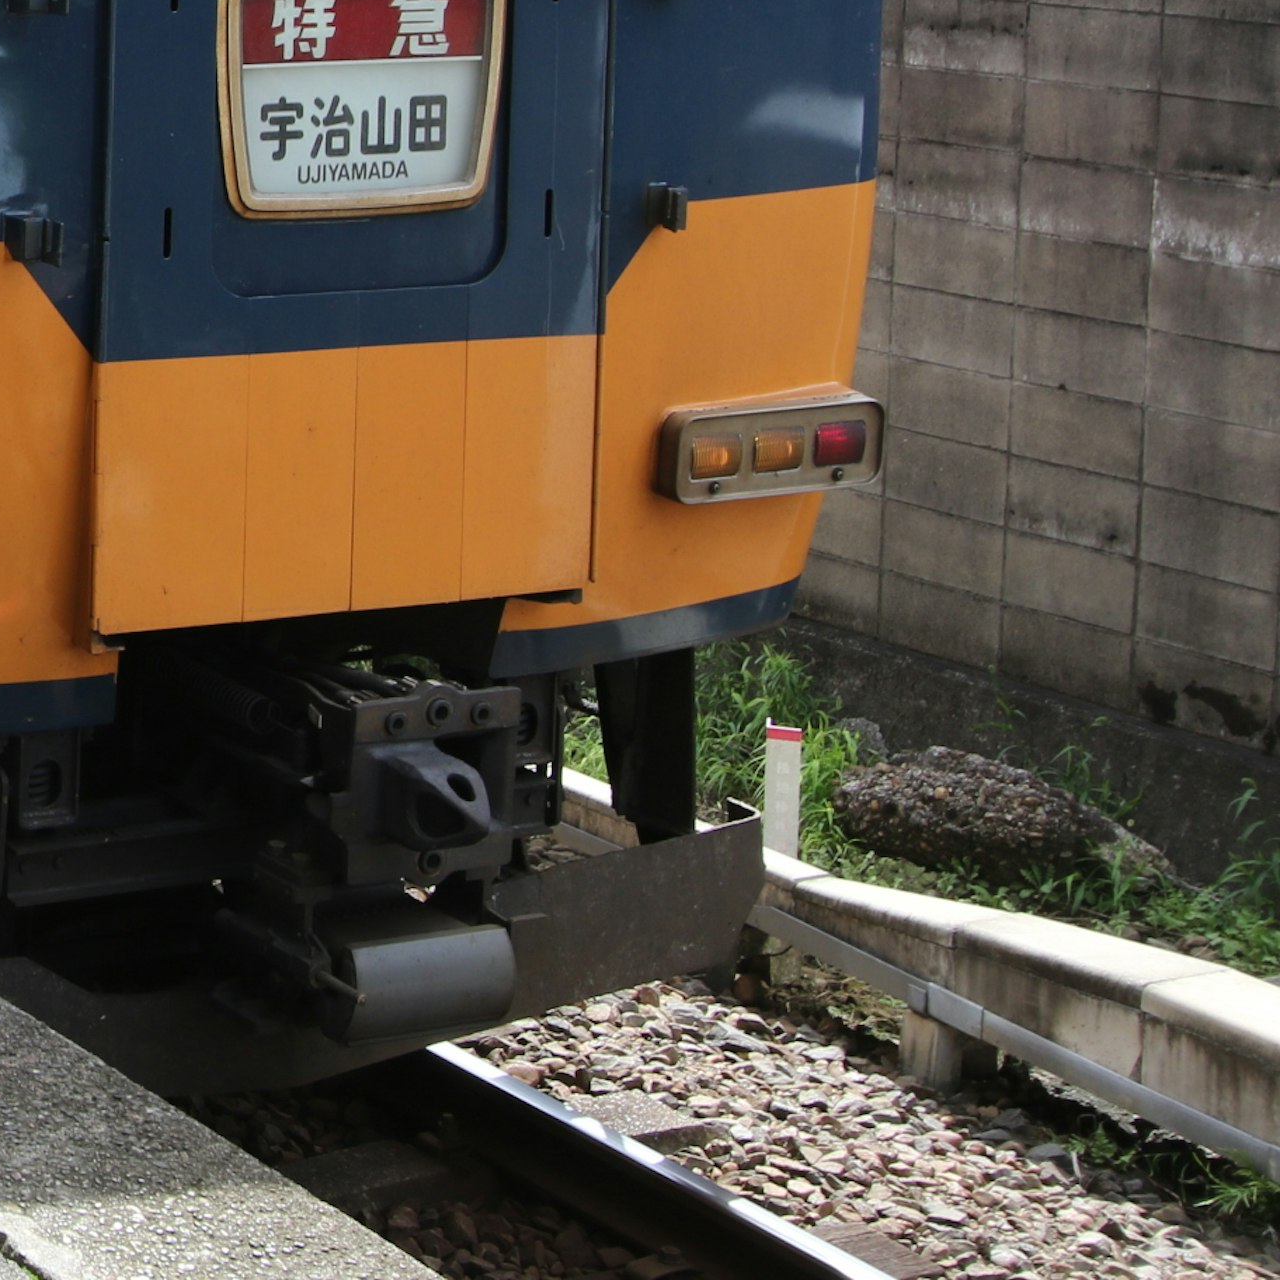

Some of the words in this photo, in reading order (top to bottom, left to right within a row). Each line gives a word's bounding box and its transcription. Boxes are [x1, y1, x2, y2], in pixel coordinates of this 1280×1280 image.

[259, 95, 448, 161] 宇治山田
[297, 160, 409, 185] UJIYAMADA
